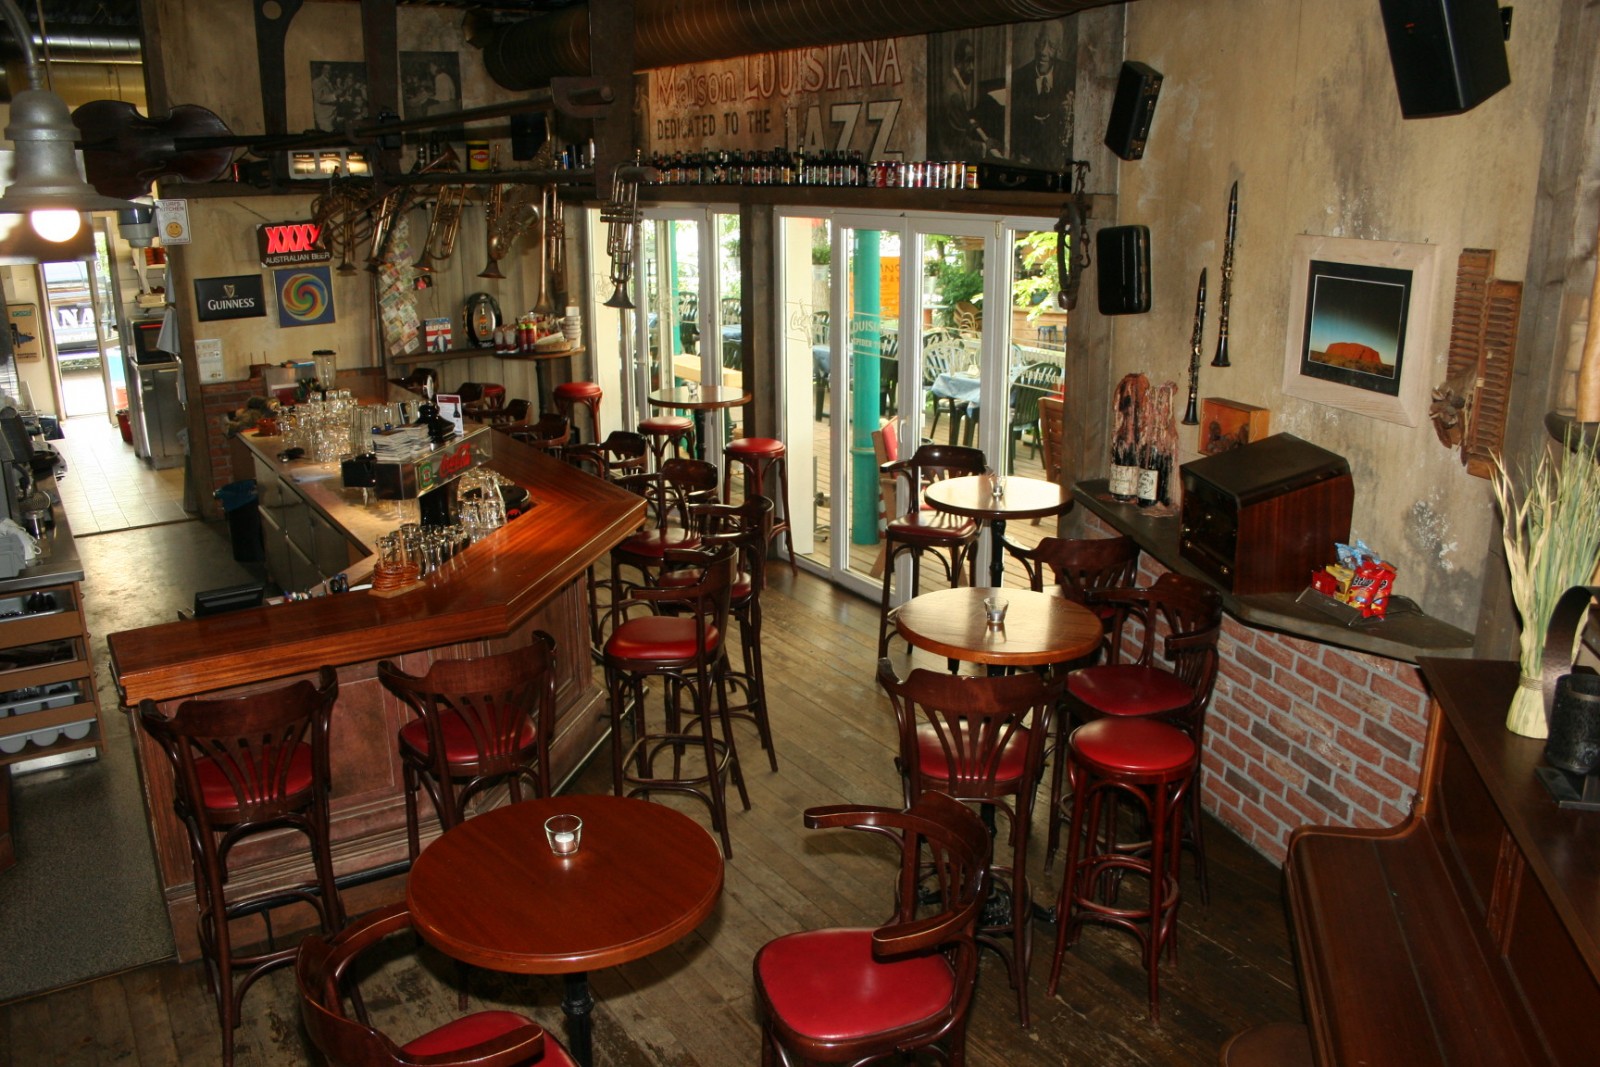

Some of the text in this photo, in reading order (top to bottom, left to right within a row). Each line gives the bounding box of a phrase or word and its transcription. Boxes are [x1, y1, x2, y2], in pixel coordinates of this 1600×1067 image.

[657, 37, 904, 107] Maison LOUISIANA
[657, 109, 771, 140] DEDICATED TO THE
[785, 99, 904, 161] JAZZ
[266, 254, 309, 264] AUSTRALIAN
[208, 298, 255, 310] GUINNESS
